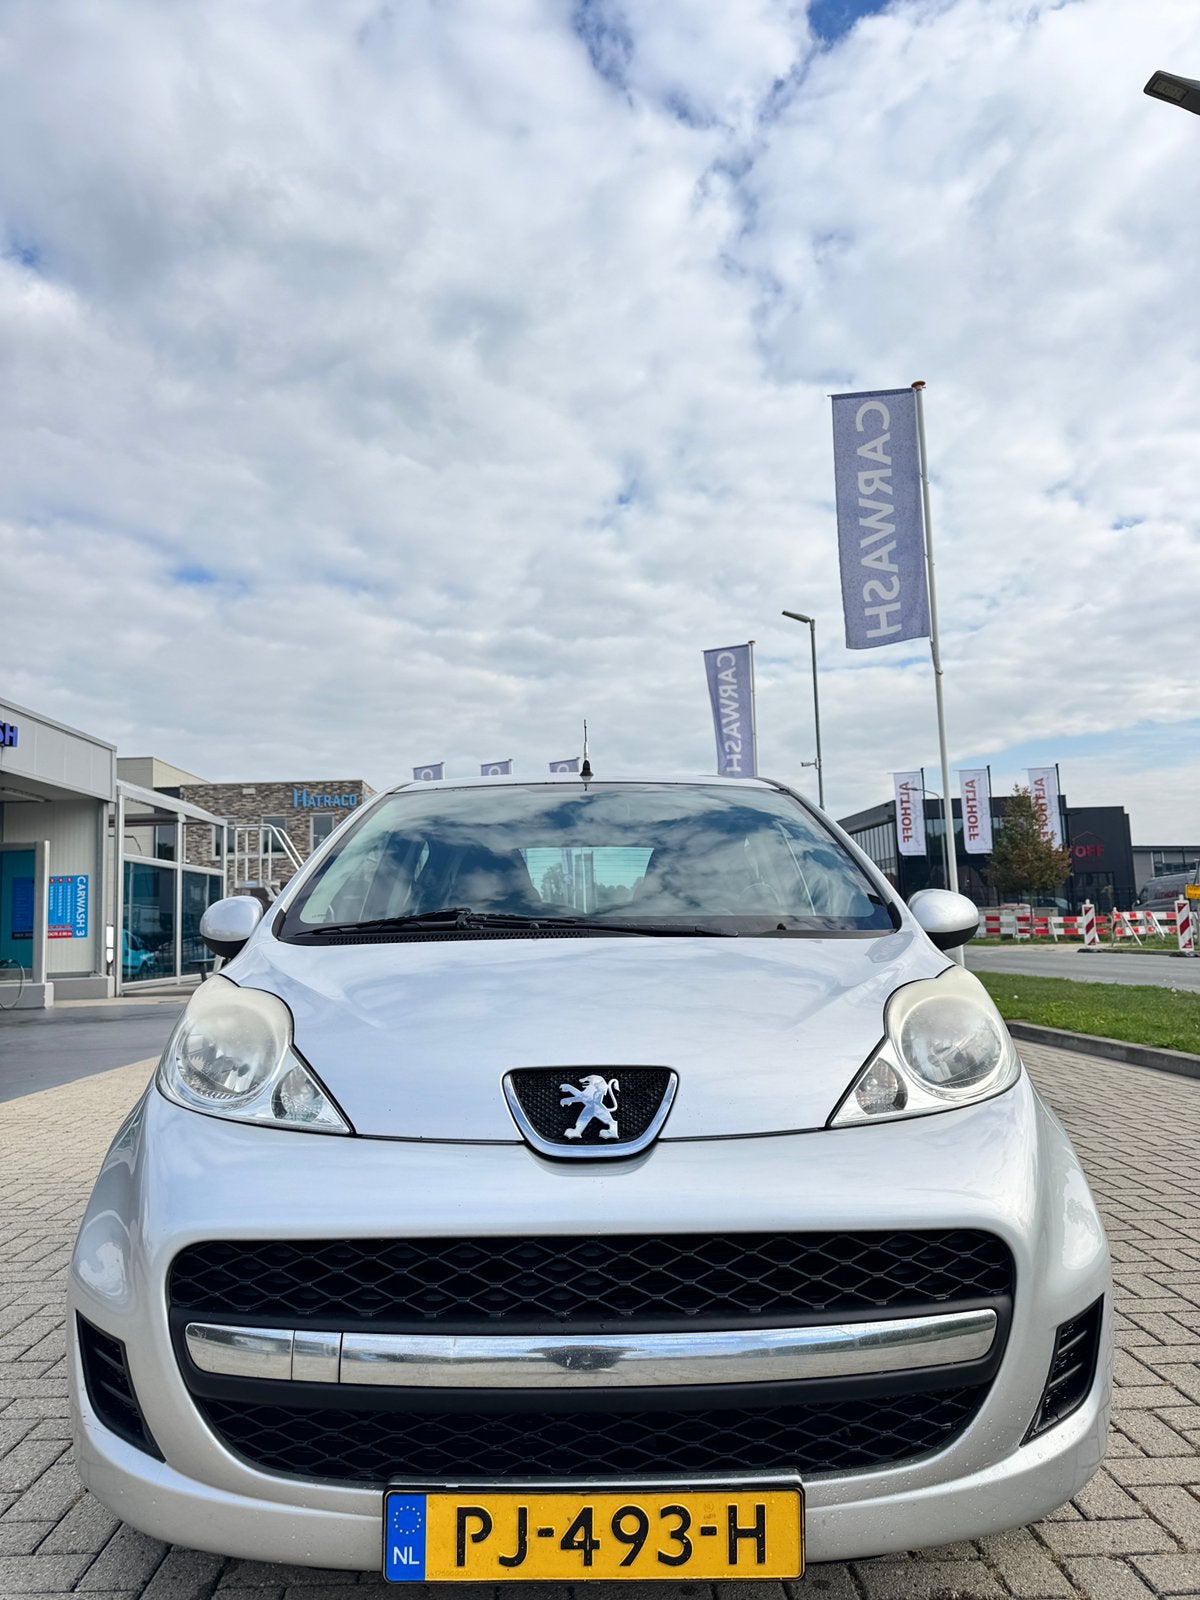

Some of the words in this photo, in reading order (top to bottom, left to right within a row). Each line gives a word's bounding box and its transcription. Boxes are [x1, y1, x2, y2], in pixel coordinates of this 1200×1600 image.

[76, 876, 87, 928] CARWASH
[392, 1545, 420, 1565] NL
[456, 1503, 766, 1568] PJ-493-H
